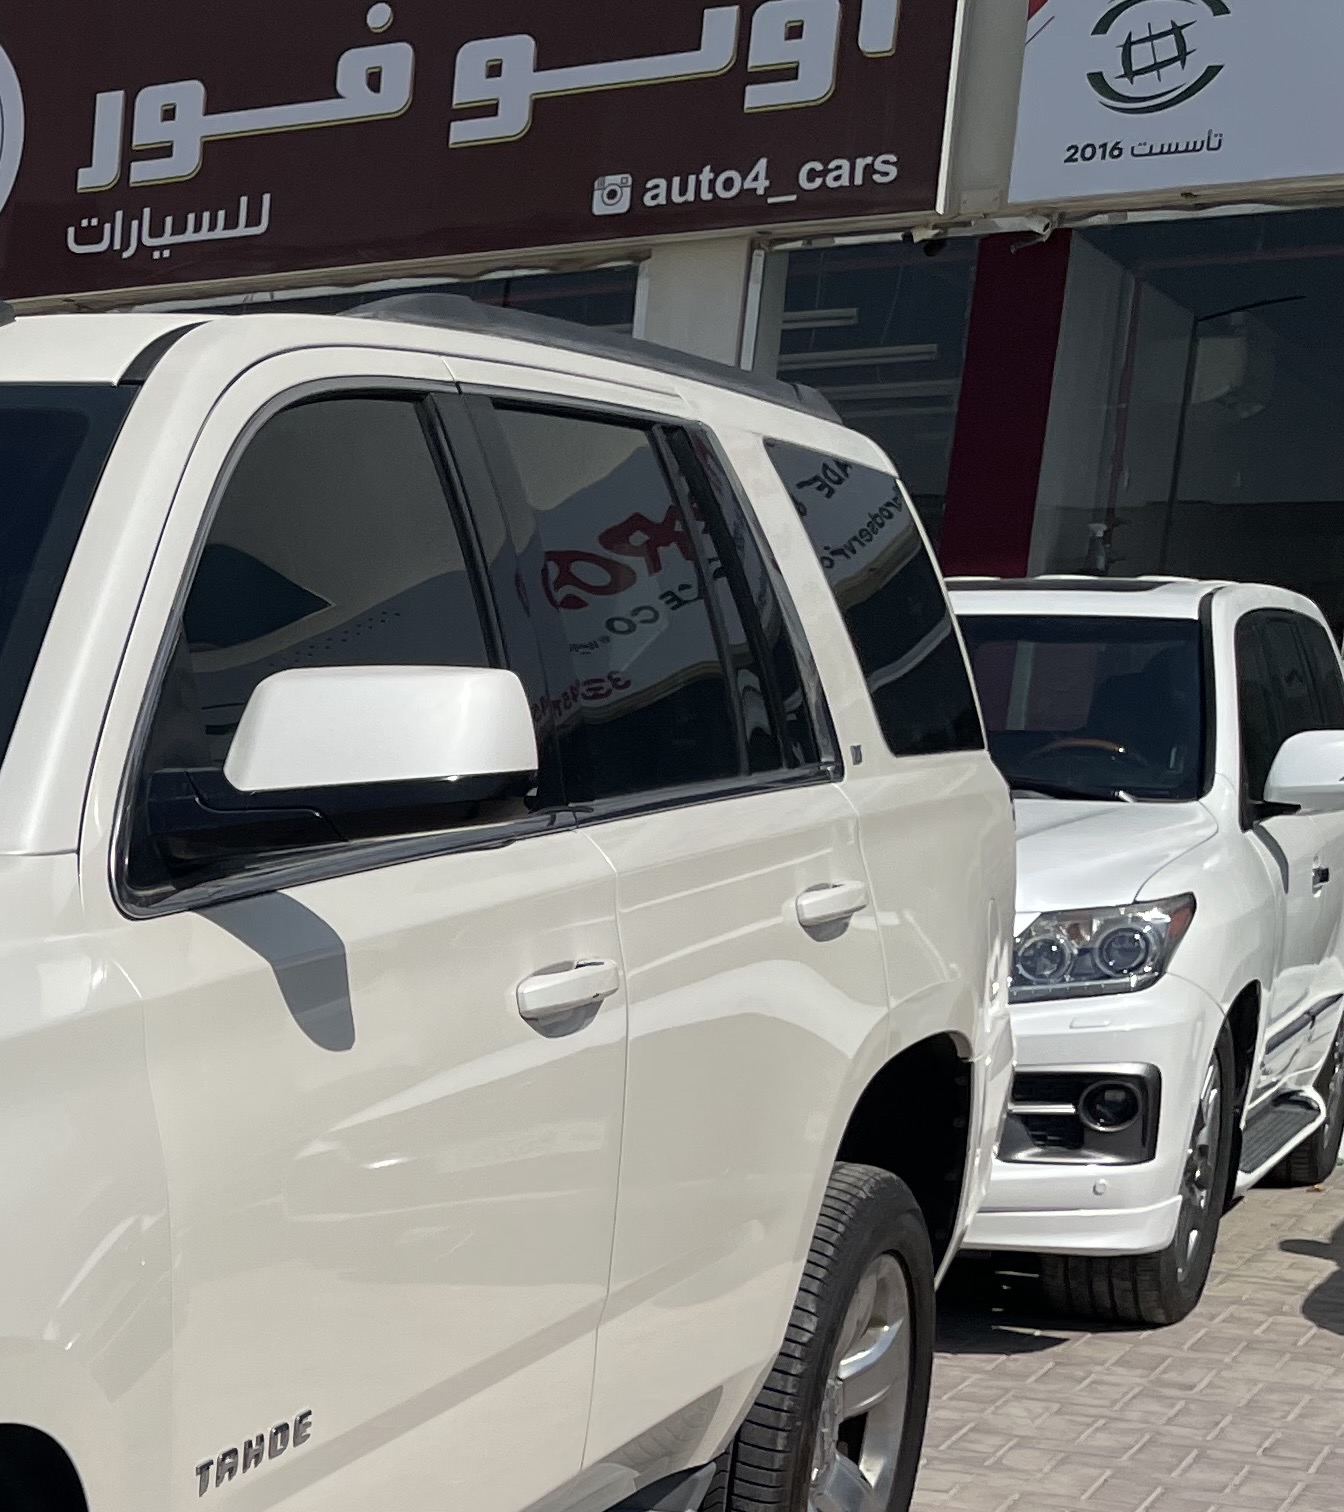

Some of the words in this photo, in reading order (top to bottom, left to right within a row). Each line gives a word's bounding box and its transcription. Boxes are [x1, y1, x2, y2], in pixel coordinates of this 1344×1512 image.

[77, 2, 415, 192] فور
[642, 151, 899, 209] auto4_cars
[1063, 140, 1124, 164] 2016
[67, 193, 272, 260] للسيارات
[195, 1406, 313, 1498] TAHOE
